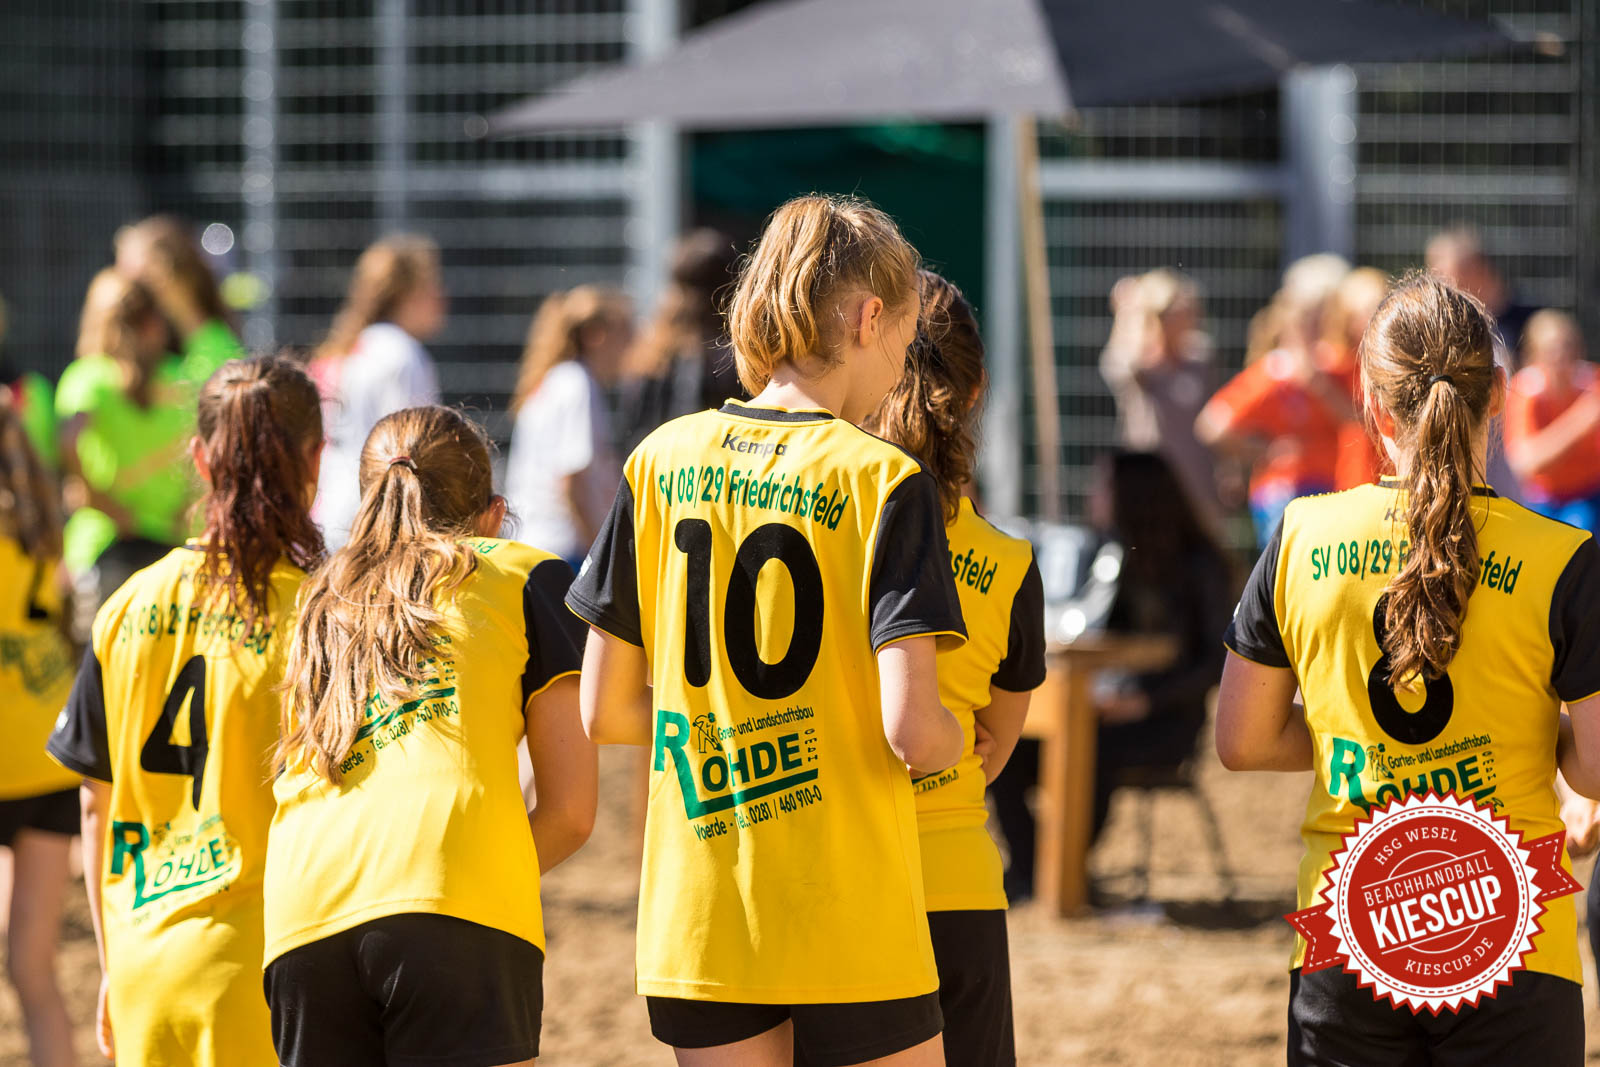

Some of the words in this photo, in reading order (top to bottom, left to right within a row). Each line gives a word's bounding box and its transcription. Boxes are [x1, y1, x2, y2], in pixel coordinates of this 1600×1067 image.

[721, 433, 788, 458] Kempa
[677, 465, 725, 509] 08/29
[727, 469, 850, 531] Friedrichsfeld
[1311, 545, 1331, 581] SV
[1337, 539, 1393, 581] 08/29
[675, 518, 824, 700] 10
[1368, 592, 1454, 744] 8
[140, 655, 210, 812] 4
[339, 751, 365, 775] oerde
[388, 718, 410, 742] 0281
[432, 701, 459, 720] 910-0
[737, 716, 753, 735] und
[752, 705, 814, 731] Landschaftsbau
[1387, 754, 1417, 769] Garten-
[1416, 747, 1433, 764] und
[1430, 734, 1492, 759] Landschaftsbau
[654, 709, 803, 820] ROHDE
[1329, 737, 1484, 817] ROHDE
[693, 816, 728, 841] Voerde
[748, 802, 773, 824] 0281
[779, 793, 797, 814] 460
[795, 785, 822, 808] 910-0
[111, 821, 225, 910] ROHDE
